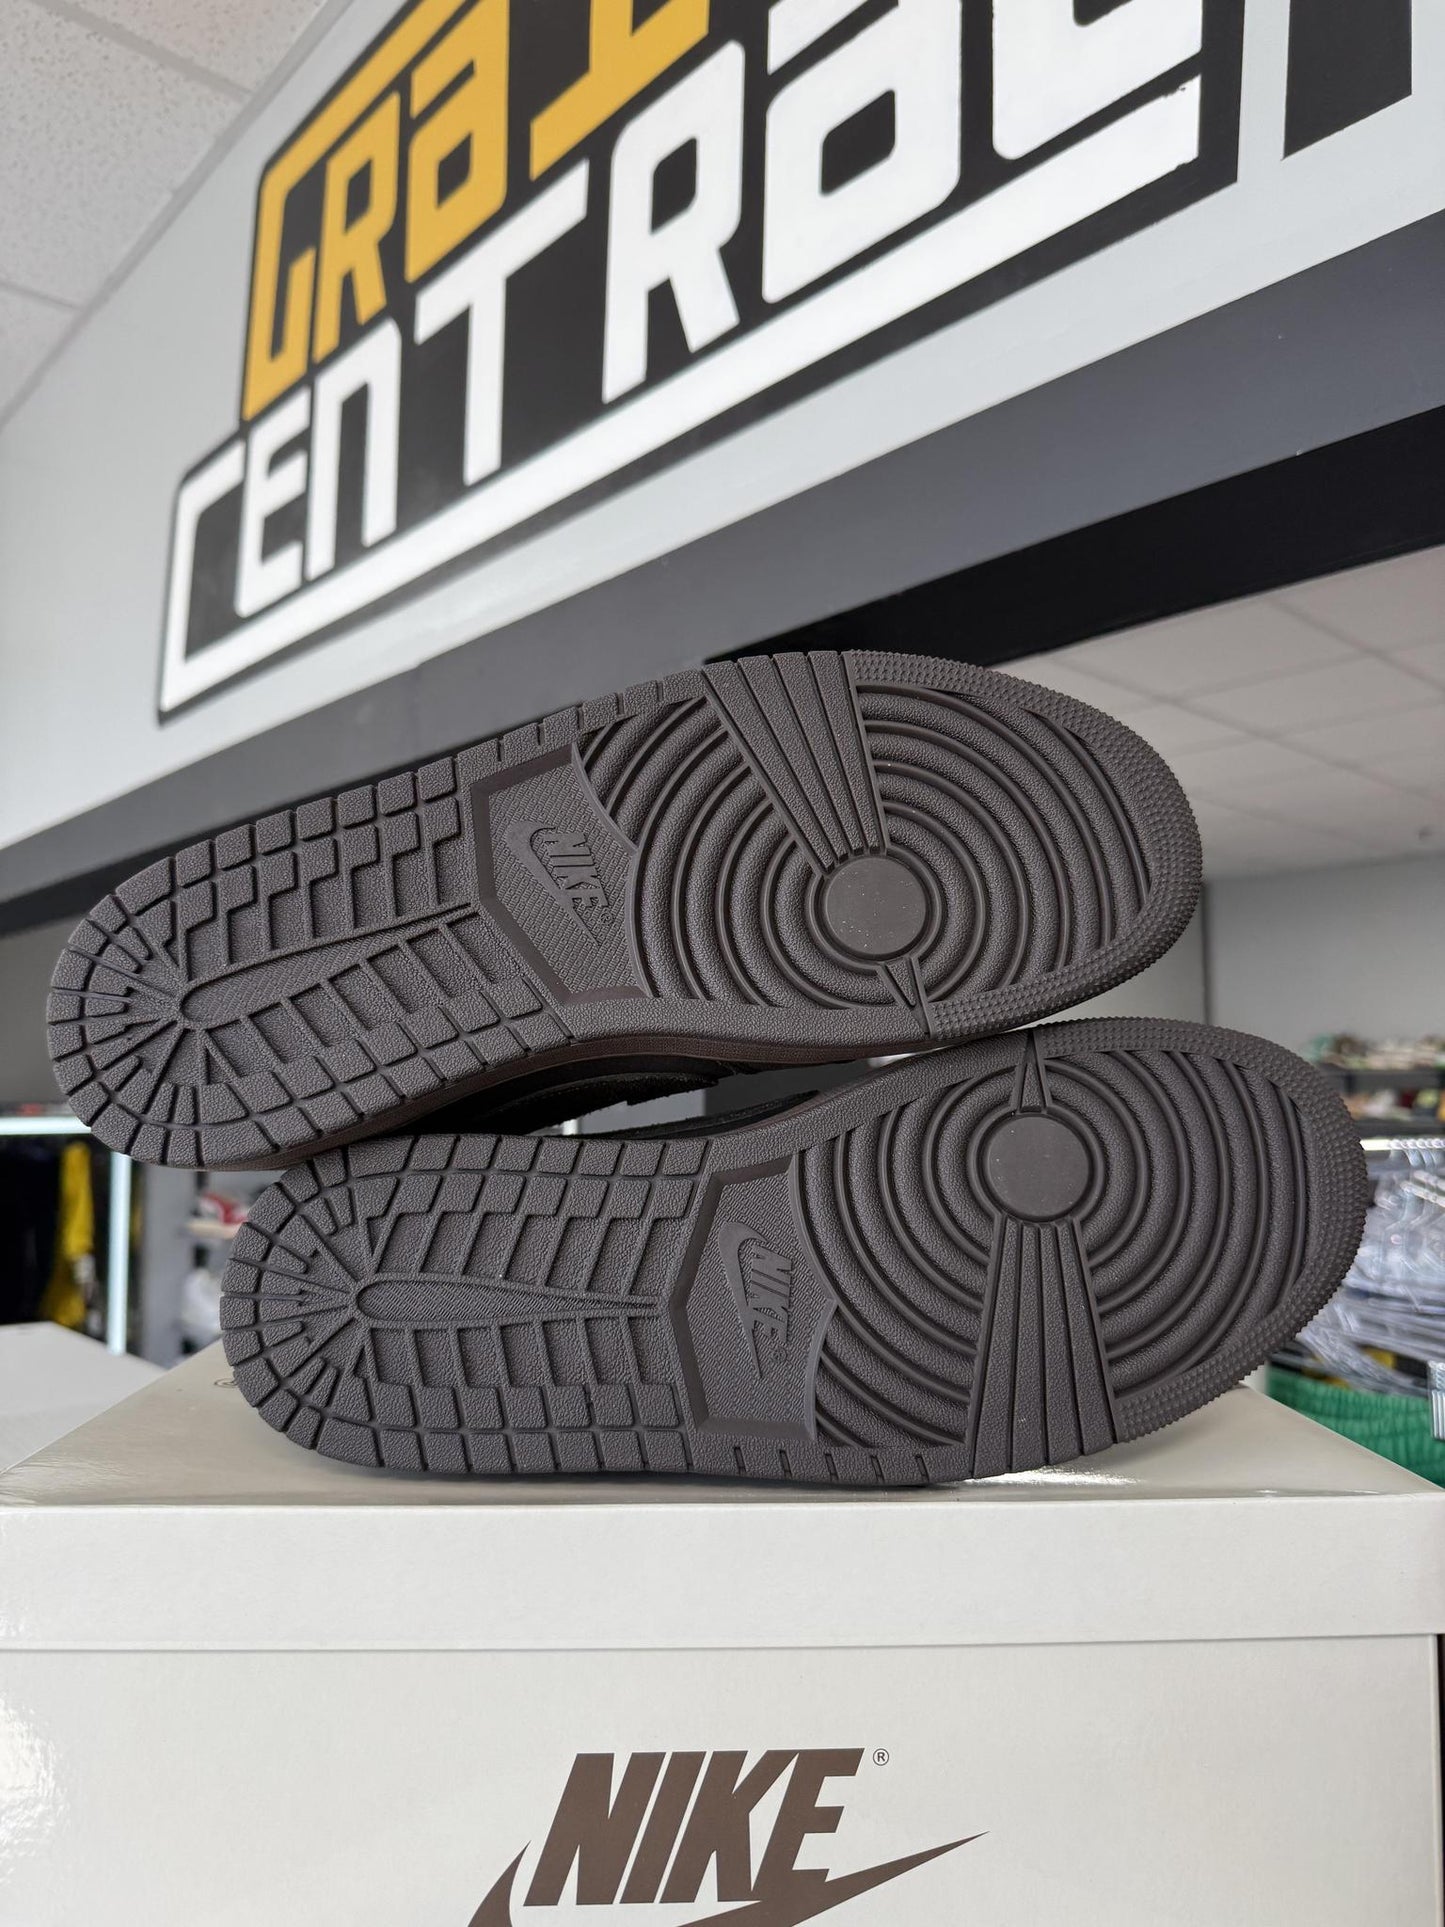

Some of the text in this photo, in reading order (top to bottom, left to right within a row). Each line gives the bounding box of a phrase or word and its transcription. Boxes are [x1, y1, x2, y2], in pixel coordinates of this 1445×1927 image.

[542, 832, 609, 908] NIKE
[750, 1243, 792, 1343] NIKE
[523, 1747, 865, 1906] NIKE
